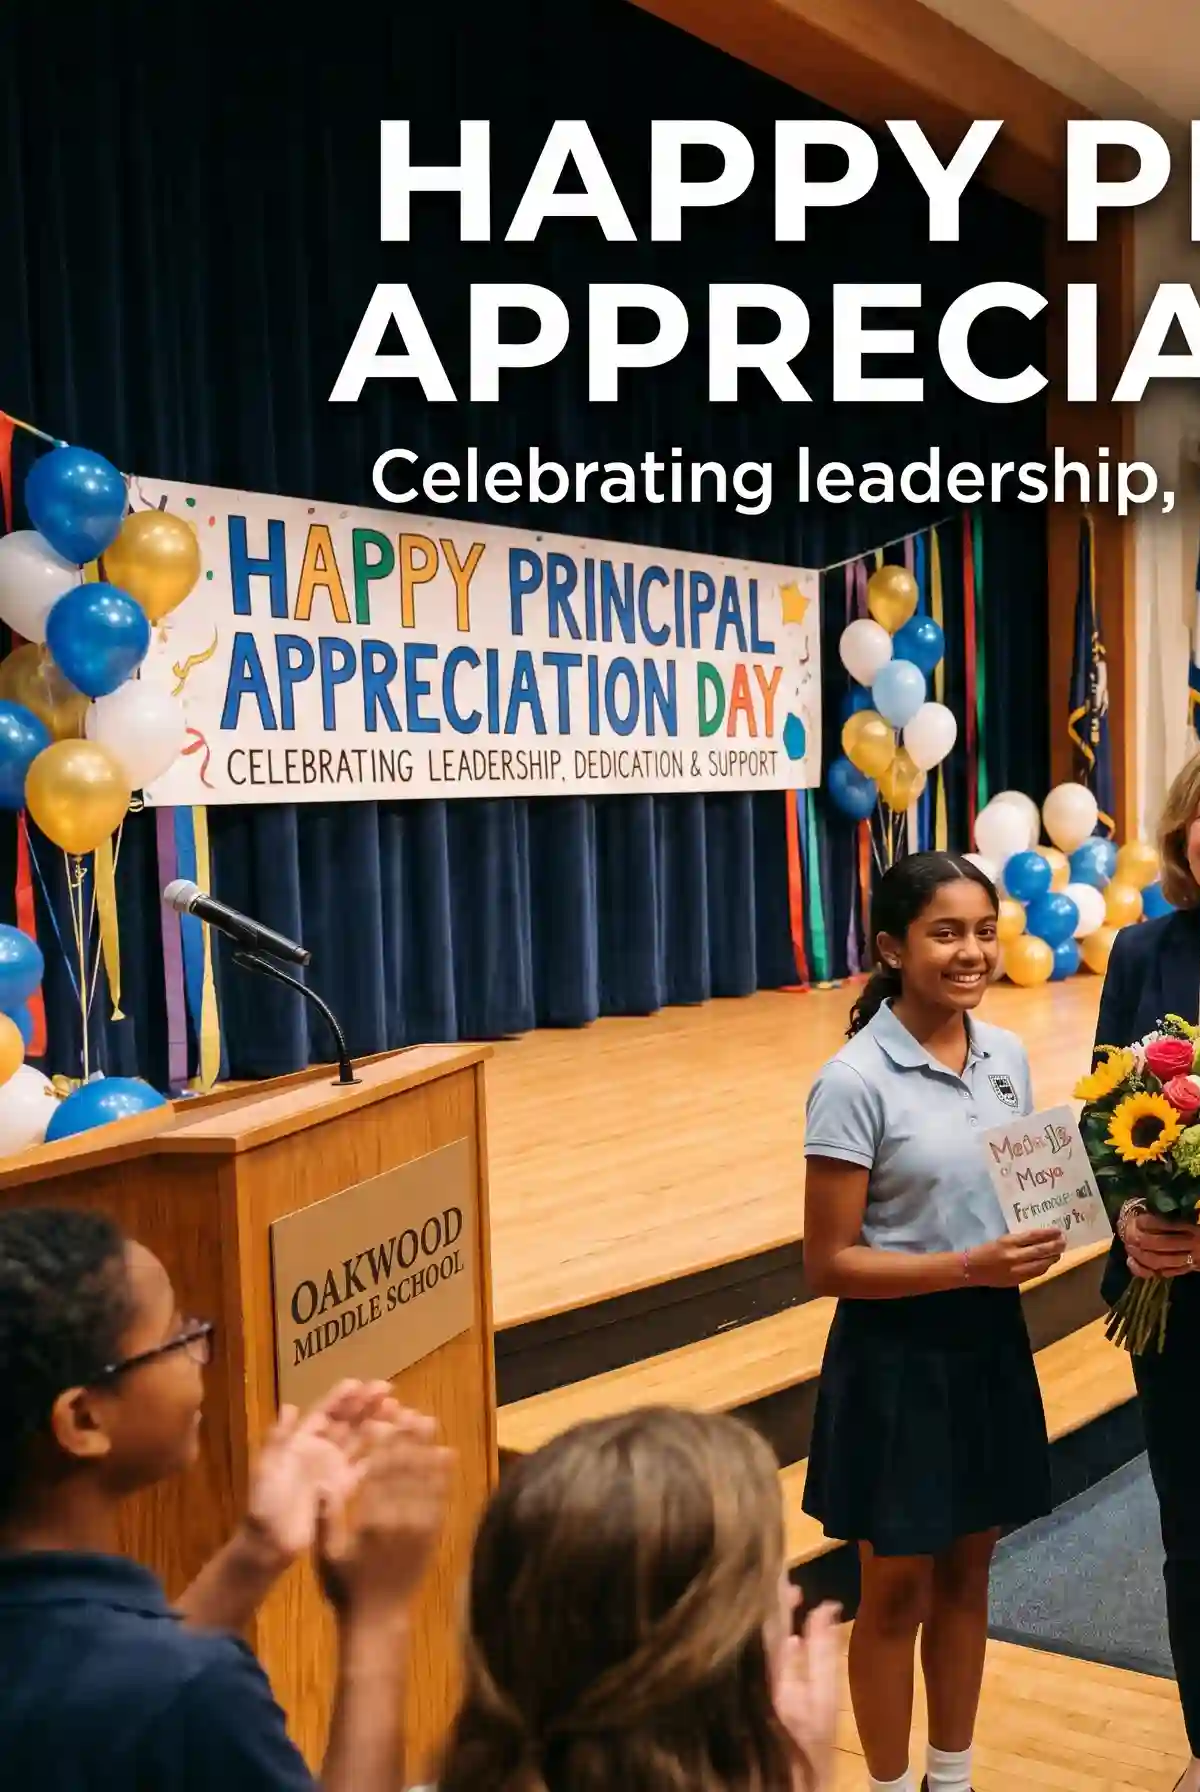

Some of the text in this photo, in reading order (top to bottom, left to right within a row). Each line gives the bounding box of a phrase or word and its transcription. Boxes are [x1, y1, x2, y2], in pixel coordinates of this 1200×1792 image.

[228, 515, 776, 655] HAPPY PRINCIPAL
[219, 632, 783, 740] APPRECIATION DAY
[226, 748, 779, 786] CELEBRATING LEADERSHIP, DEDICATION & SUPPORT
[291, 1206, 463, 1325] OAKWOOD
[292, 1250, 465, 1367] MIDDLE SCHOOL
